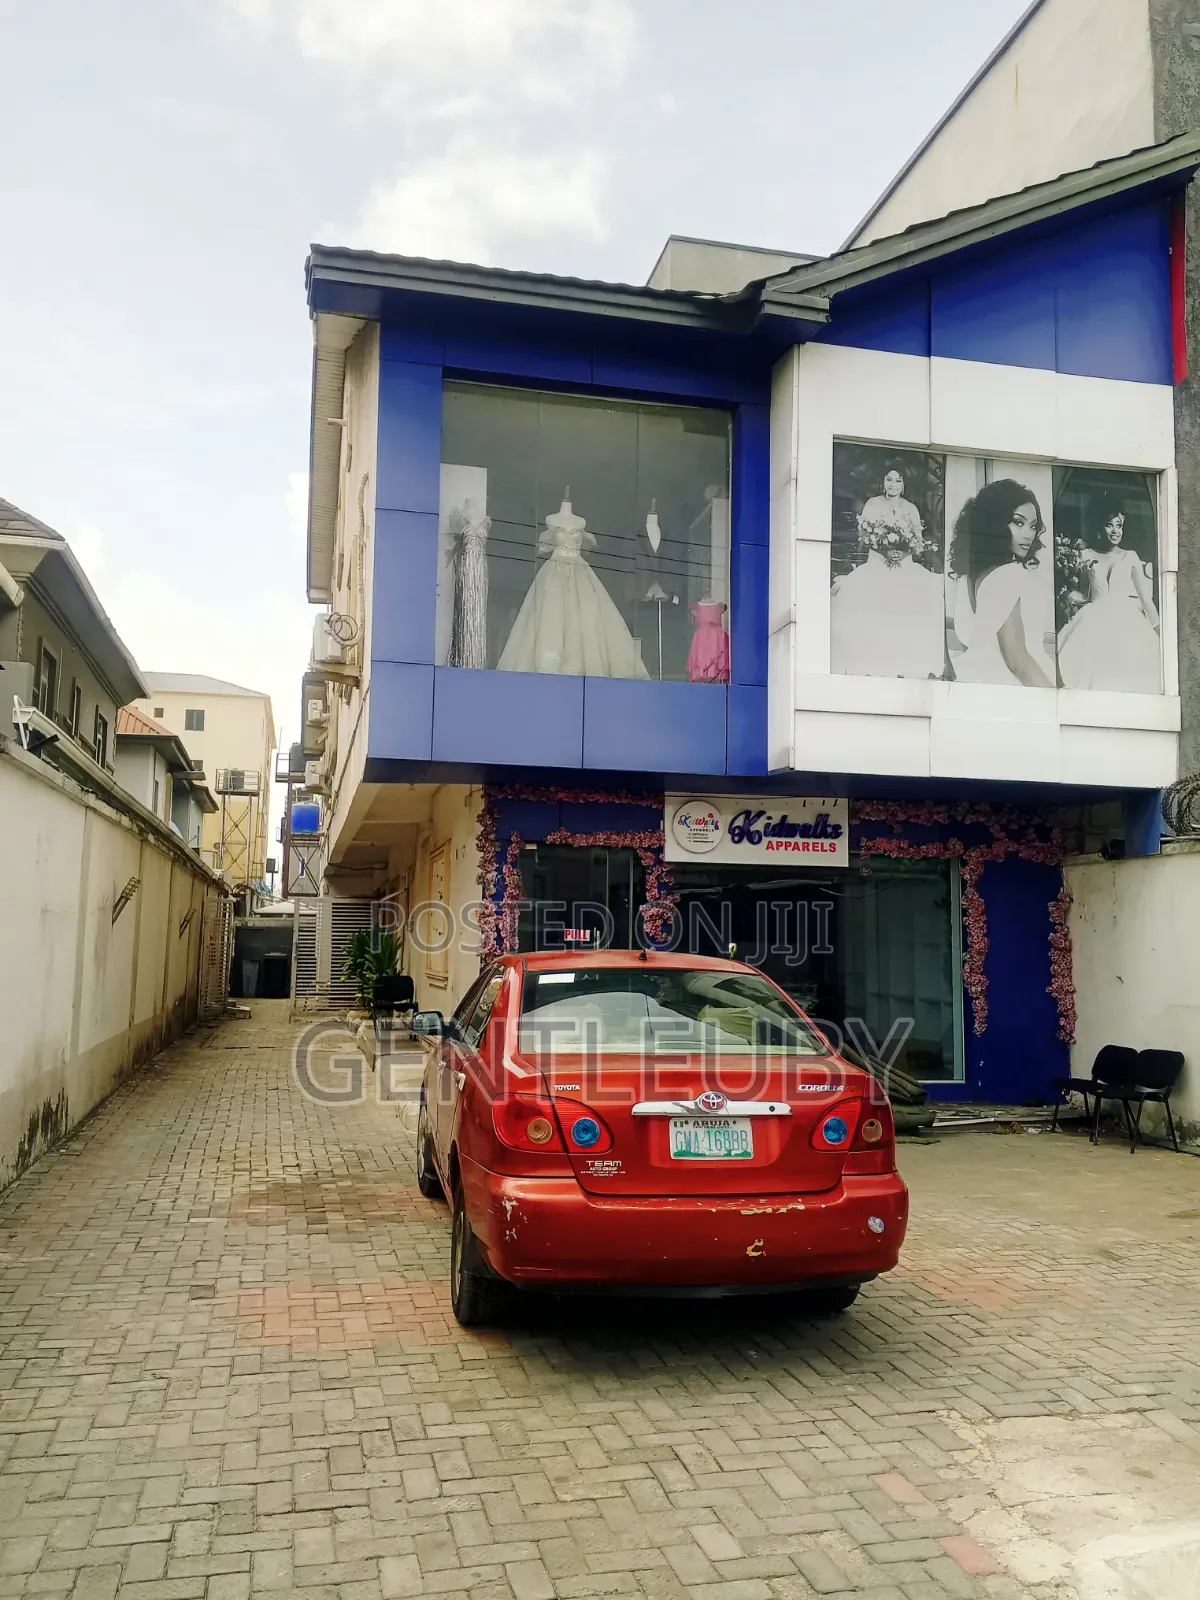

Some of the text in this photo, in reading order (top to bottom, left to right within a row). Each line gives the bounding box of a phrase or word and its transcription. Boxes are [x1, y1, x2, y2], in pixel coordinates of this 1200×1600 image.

[728, 810, 843, 845] Kidwalks
[765, 840, 837, 853] APPARELS
[564, 929, 588, 940] PULL
[798, 1084, 845, 1092] COROLLA
